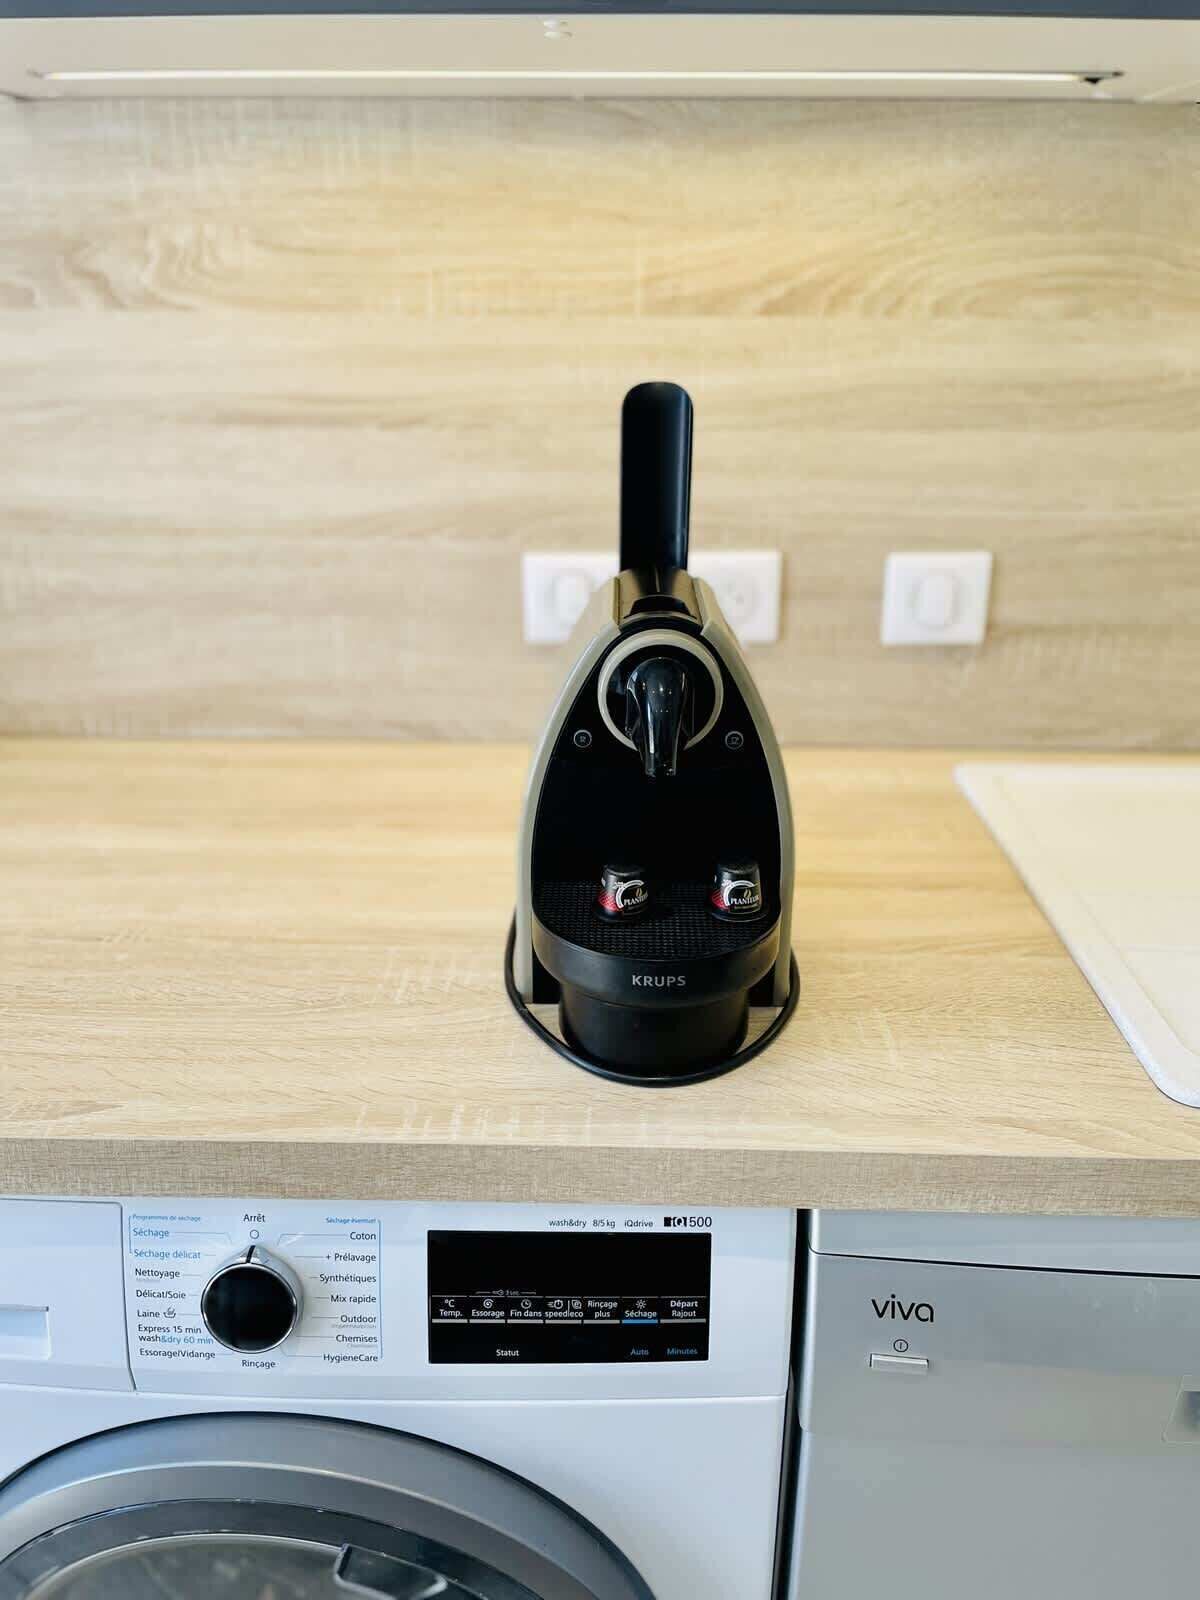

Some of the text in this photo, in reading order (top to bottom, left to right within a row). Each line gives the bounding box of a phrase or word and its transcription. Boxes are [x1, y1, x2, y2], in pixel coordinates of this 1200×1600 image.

[632, 975, 686, 987] KRUPS
[243, 1213, 265, 1222] Arrêt
[549, 1218, 616, 1229] wash&dry 8/5 kg
[624, 1219, 653, 1227] iQdrive
[132, 1228, 169, 1239] Séchage
[349, 1231, 377, 1241] Coton
[134, 1248, 201, 1259] Séchage délicat
[334, 1252, 377, 1263] Prélavage
[135, 1268, 180, 1279] Nettoyage
[319, 1273, 377, 1284] Synthétiques
[136, 1289, 186, 1299] Délicat/Soie
[330, 1294, 377, 1304] Mix rapide
[587, 1300, 618, 1310] Rinçage
[670, 1300, 698, 1310] Départ
[871, 1293, 934, 1323] viva
[137, 1309, 160, 1318] Laine
[440, 1309, 463, 1318] Temp.
[471, 1309, 505, 1318] Essorage
[523, 1309, 542, 1317] dans
[594, 1310, 611, 1319] plus
[624, 1309, 657, 1319] Séchage
[671, 1309, 697, 1319] Rajout
[340, 1314, 377, 1323] Outdoor
[138, 1324, 202, 1334] Express 15 min
[138, 1334, 214, 1345] wash&dry 60 min
[335, 1334, 378, 1343] Chemises
[140, 1348, 216, 1360] Essorage/Vidange
[495, 1348, 520, 1357] Statut
[630, 1348, 649, 1356] Auto
[667, 1347, 698, 1355] Minutes
[323, 1354, 379, 1364] HygieneCare
[241, 1360, 276, 1370] Rinçage
